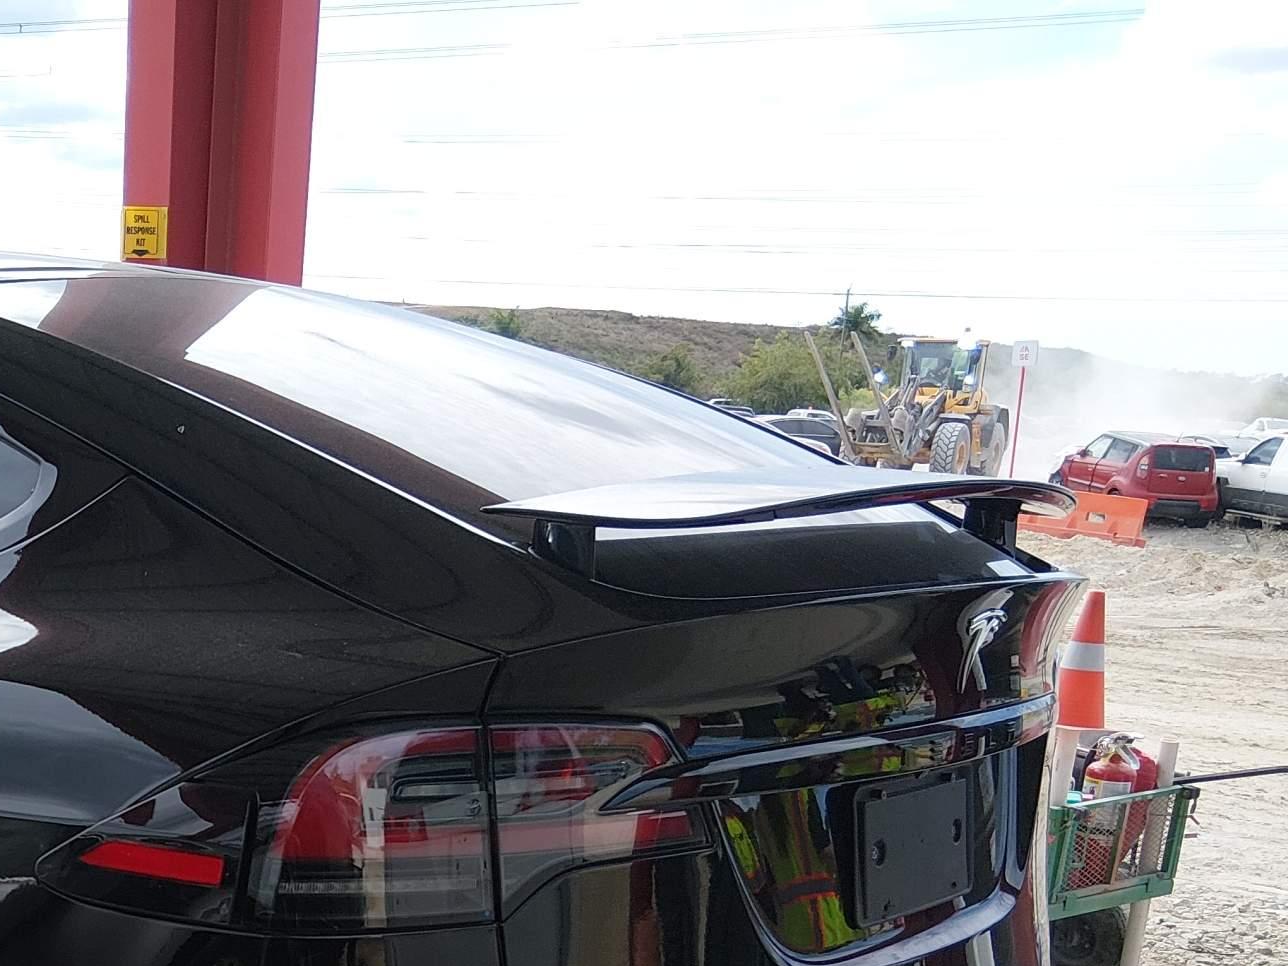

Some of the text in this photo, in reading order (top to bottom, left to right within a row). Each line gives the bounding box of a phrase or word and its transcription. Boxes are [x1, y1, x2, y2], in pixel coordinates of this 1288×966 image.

[134, 214, 150, 223] SPILL
[126, 227, 156, 235] RESPONSE
[136, 239, 146, 247] KIT
